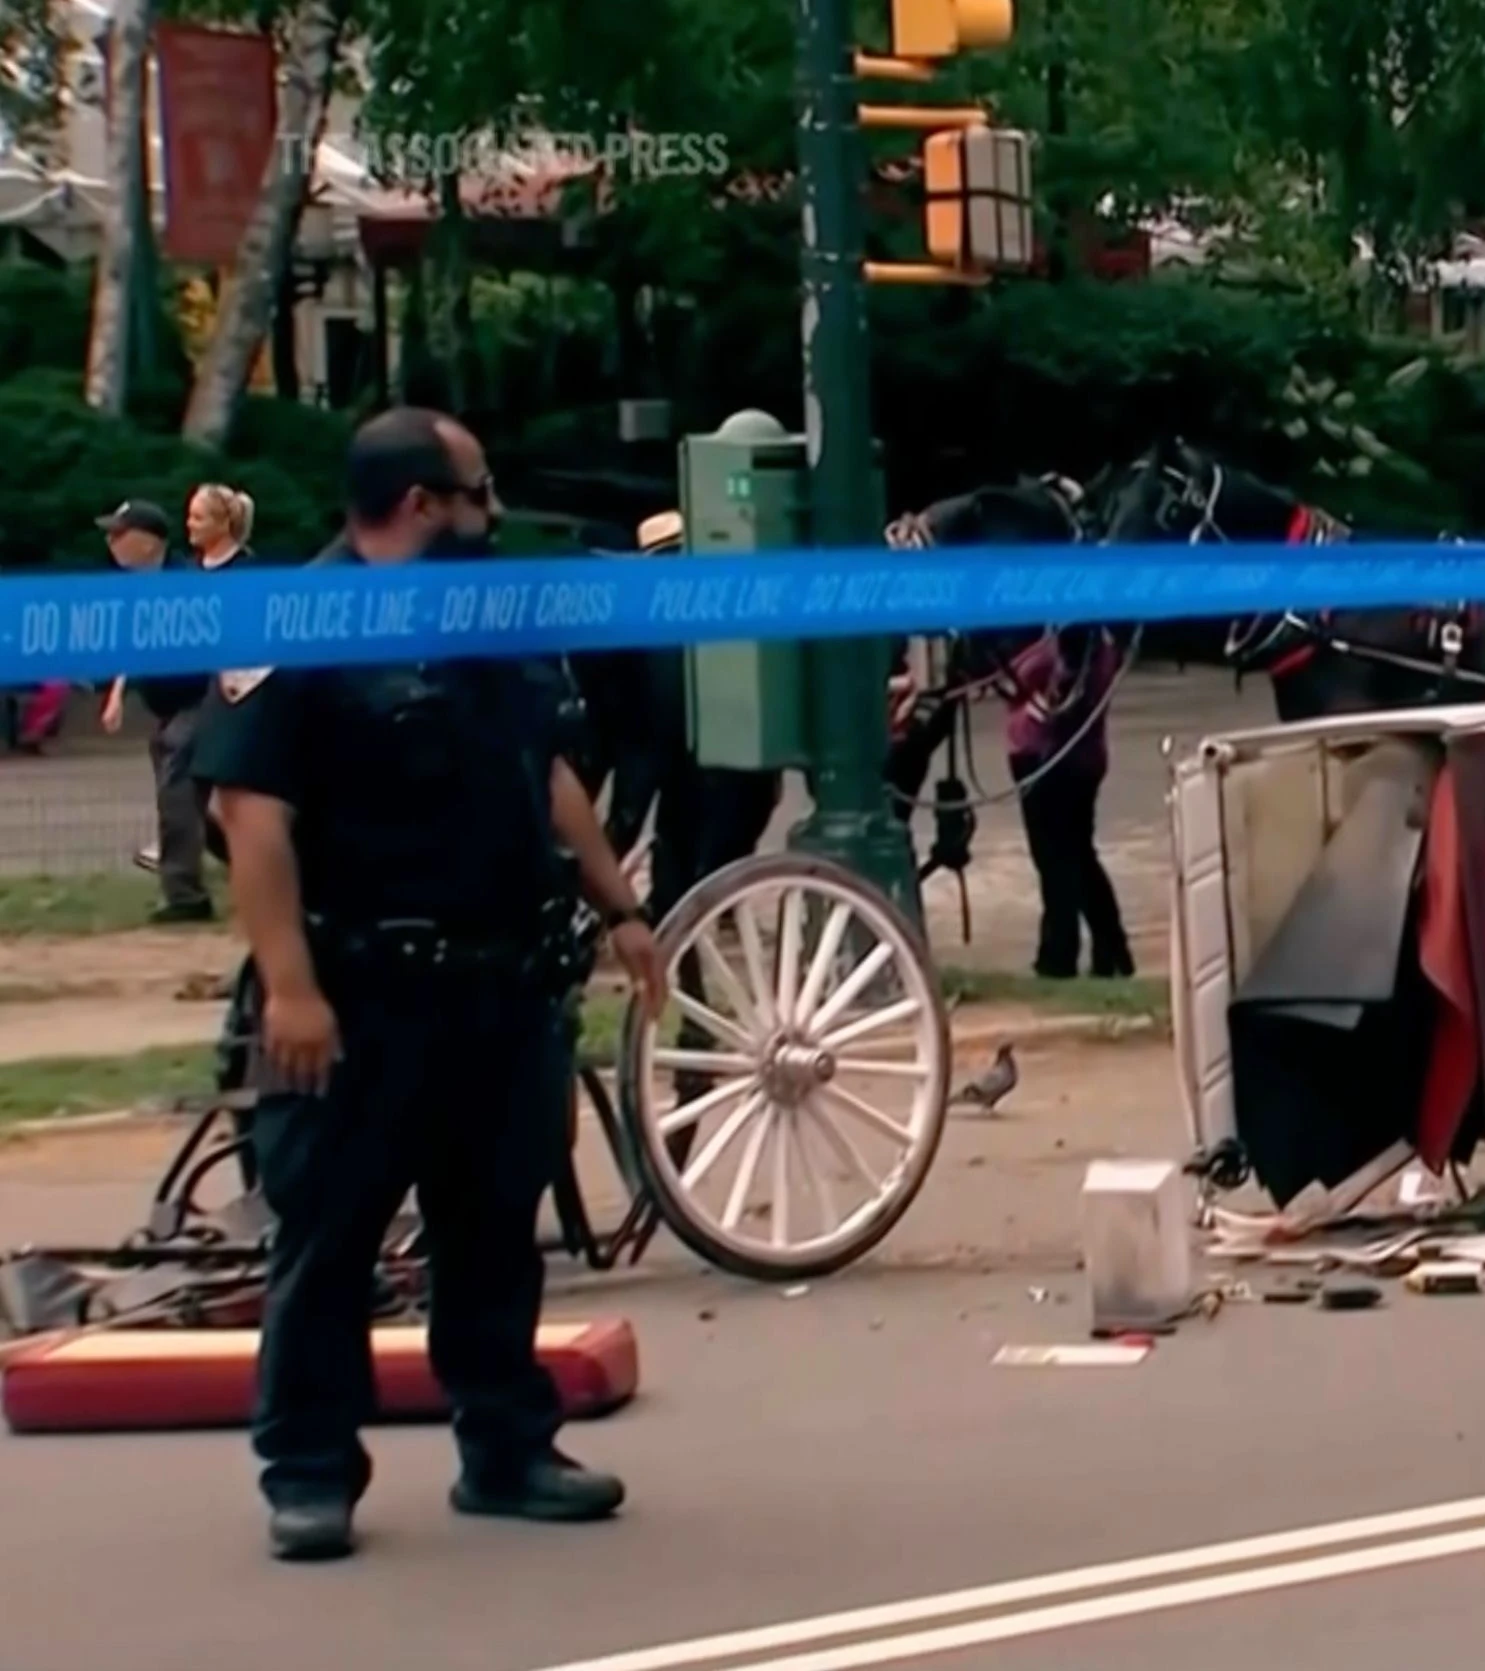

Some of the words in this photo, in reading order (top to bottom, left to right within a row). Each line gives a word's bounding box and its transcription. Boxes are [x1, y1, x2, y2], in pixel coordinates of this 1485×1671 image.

[21, 601, 60, 656] DO
[68, 597, 126, 653] NOT
[132, 593, 222, 650] CROSS
[264, 589, 355, 642] POLICE
[362, 586, 419, 637] LINE
[439, 584, 477, 633] DO
[480, 582, 530, 631] NOT
[535, 580, 617, 628] CROSS
[649, 573, 735, 622] POLICE
